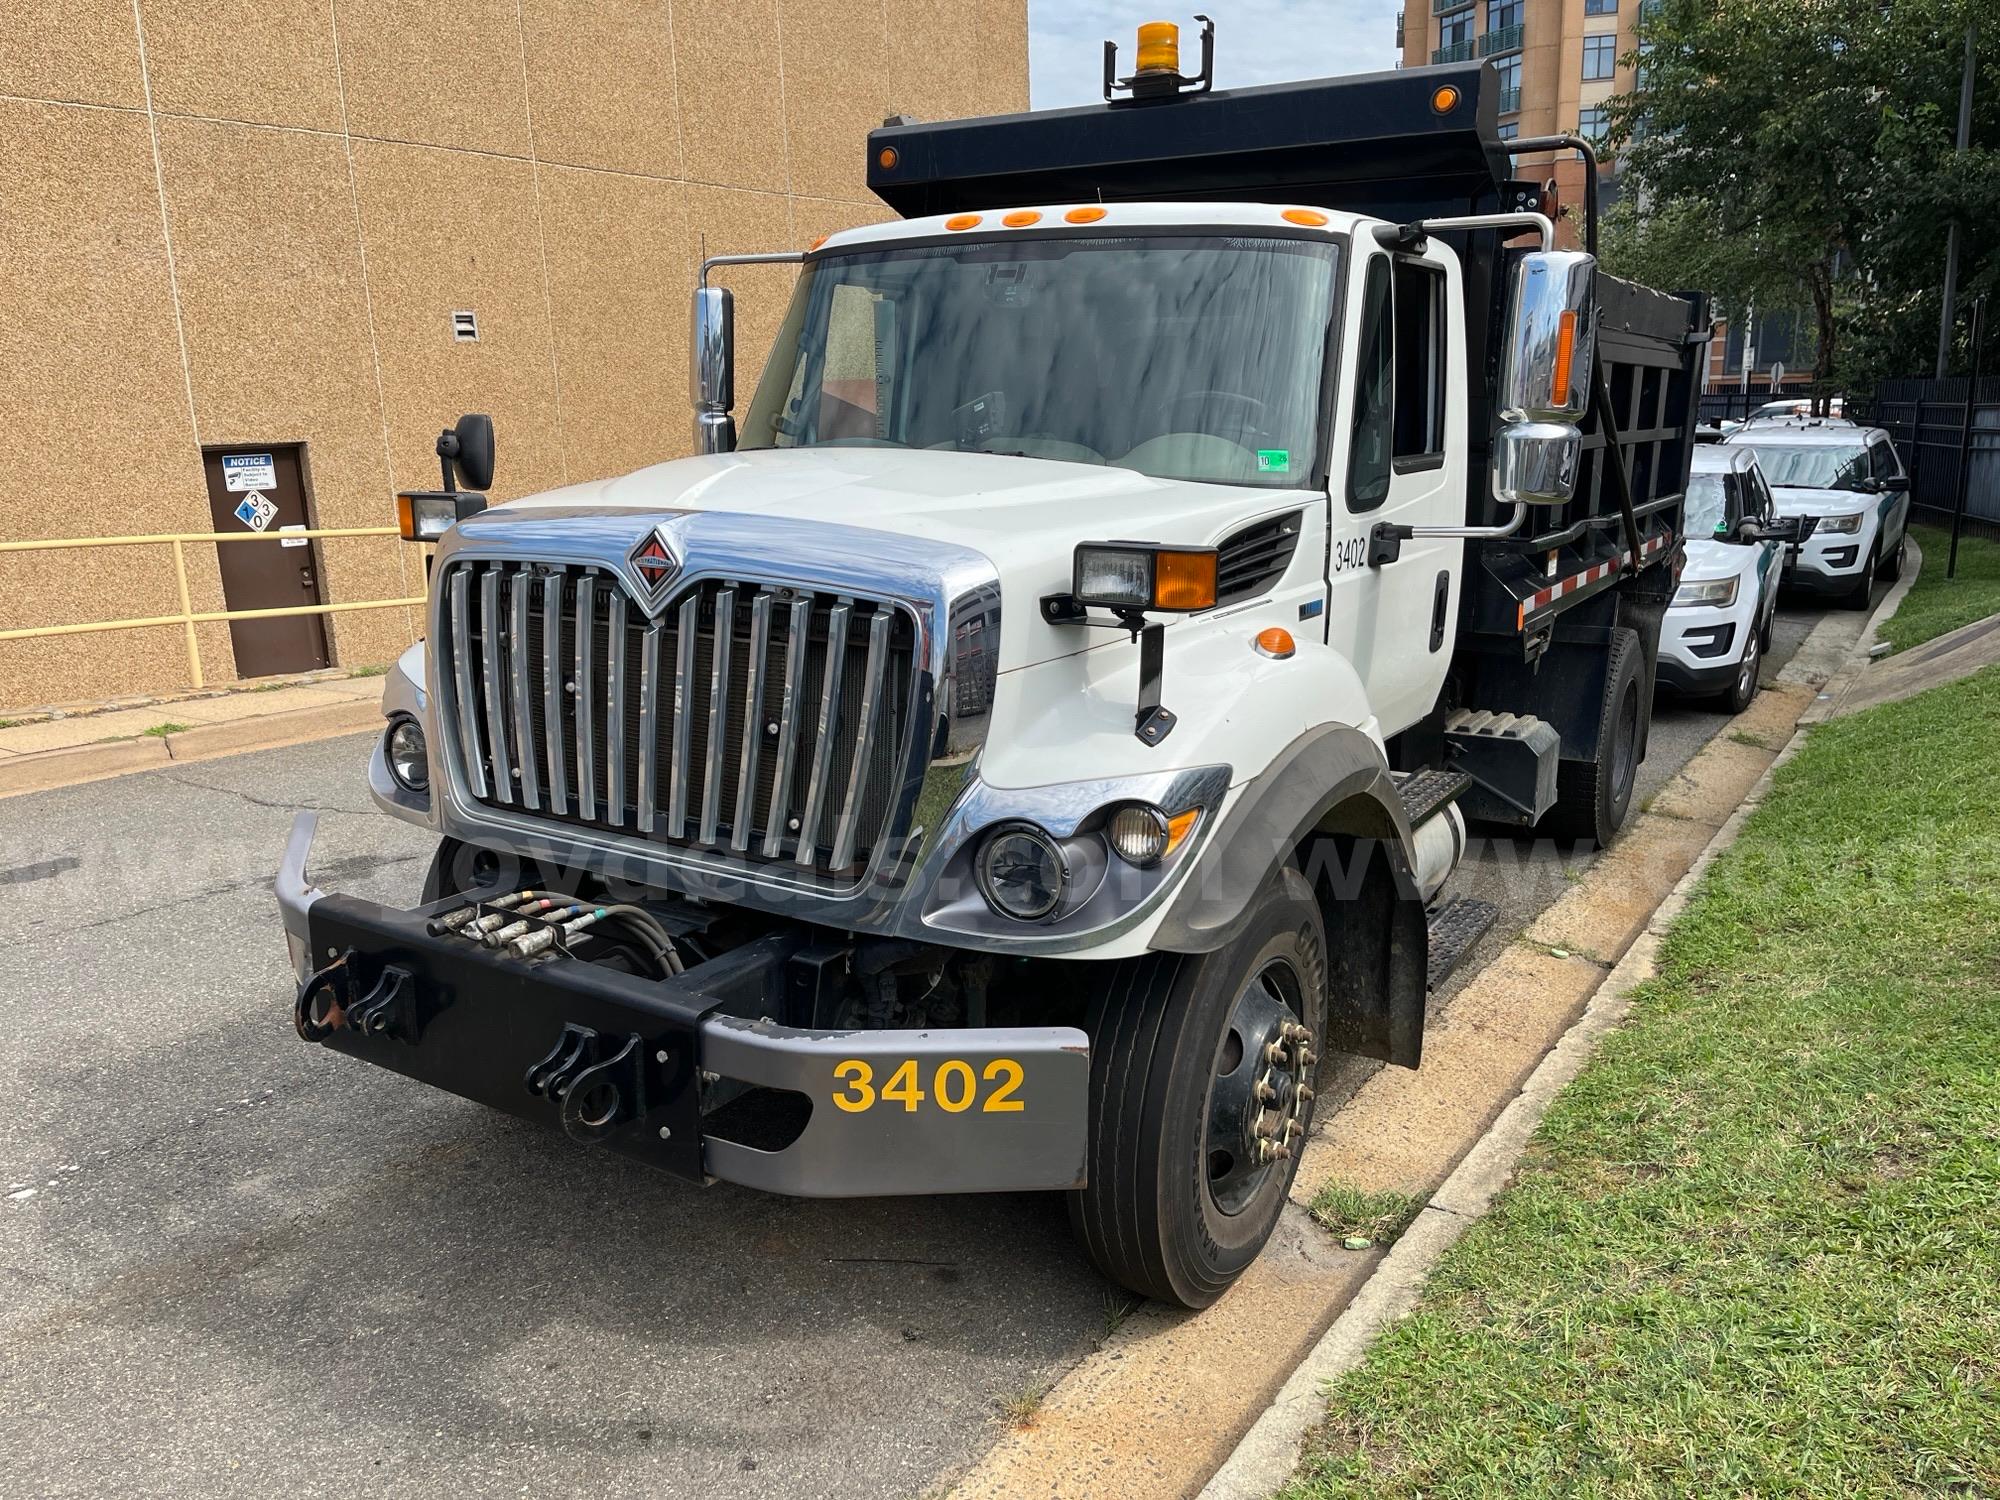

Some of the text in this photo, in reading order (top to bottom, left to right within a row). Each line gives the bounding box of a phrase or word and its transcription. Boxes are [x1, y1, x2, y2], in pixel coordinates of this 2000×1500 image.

[231, 457, 266, 467] NOTICE
[250, 494, 259, 507] 3
[262, 503, 271, 517] 3
[253, 515, 263, 528] 0
[1335, 537, 1366, 572] 3402
[832, 1058, 1025, 1113] 3402
